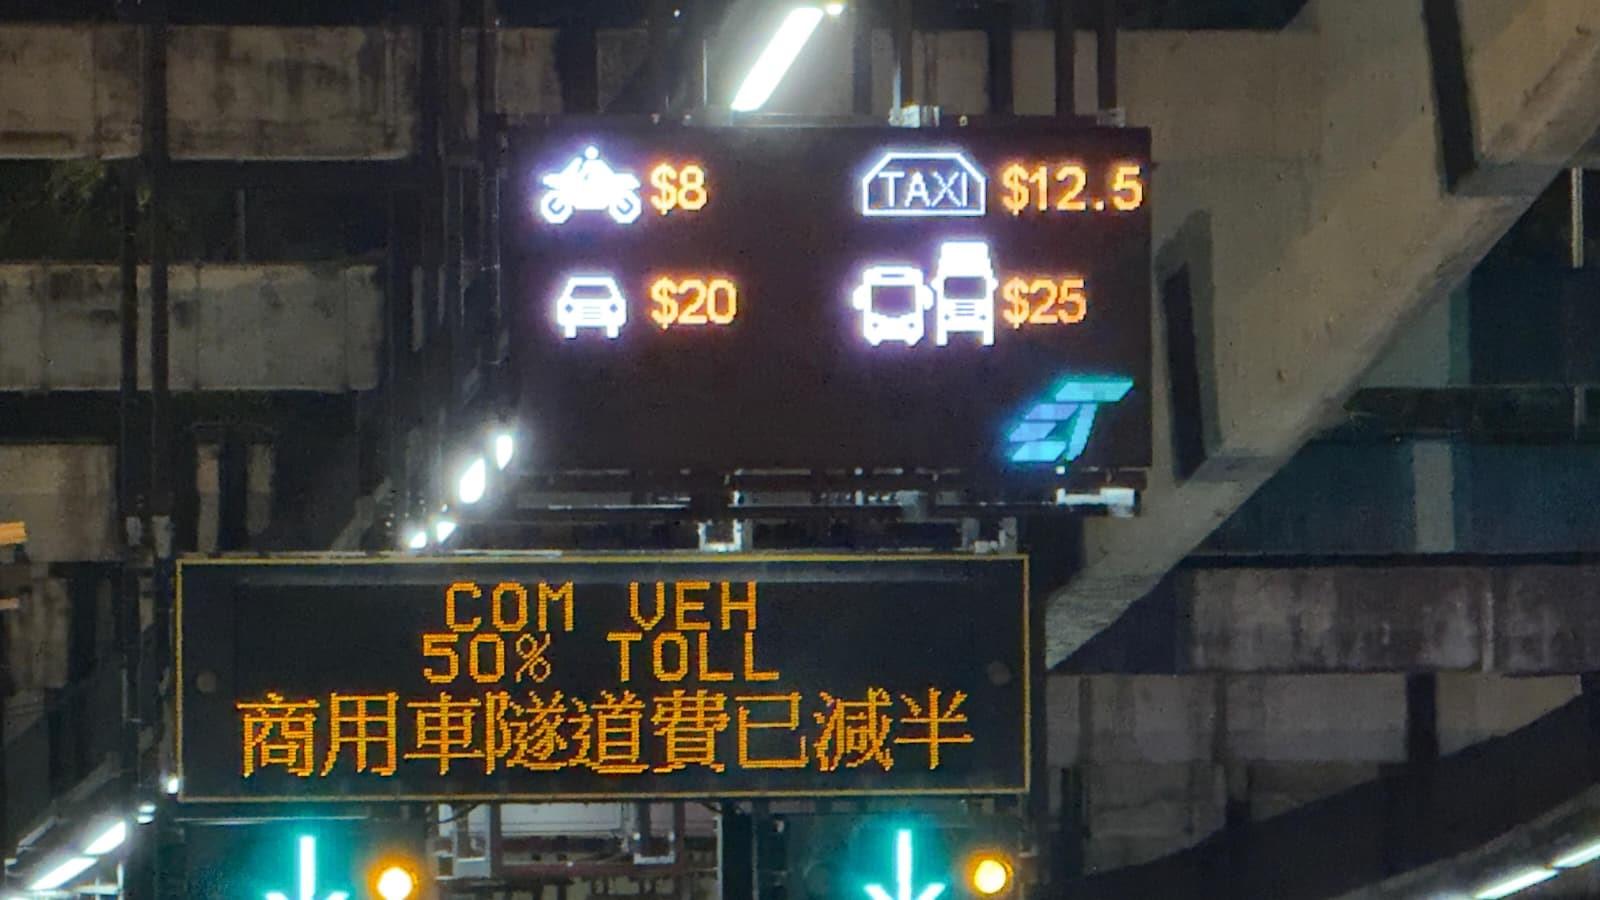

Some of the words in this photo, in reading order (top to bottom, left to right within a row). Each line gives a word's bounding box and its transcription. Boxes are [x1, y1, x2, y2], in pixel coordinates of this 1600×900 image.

[647, 162, 707, 214] $8
[880, 170, 969, 209] TAXI
[1002, 162, 1142, 214] $12.5
[650, 277, 738, 329] $20
[1002, 277, 1087, 328] $25
[445, 581, 575, 632] COM
[629, 581, 758, 632] VEH
[423, 632, 552, 684] 50%
[607, 632, 780, 682] TOLL
[236, 687, 974, 779] 商用車隧道費已減半
